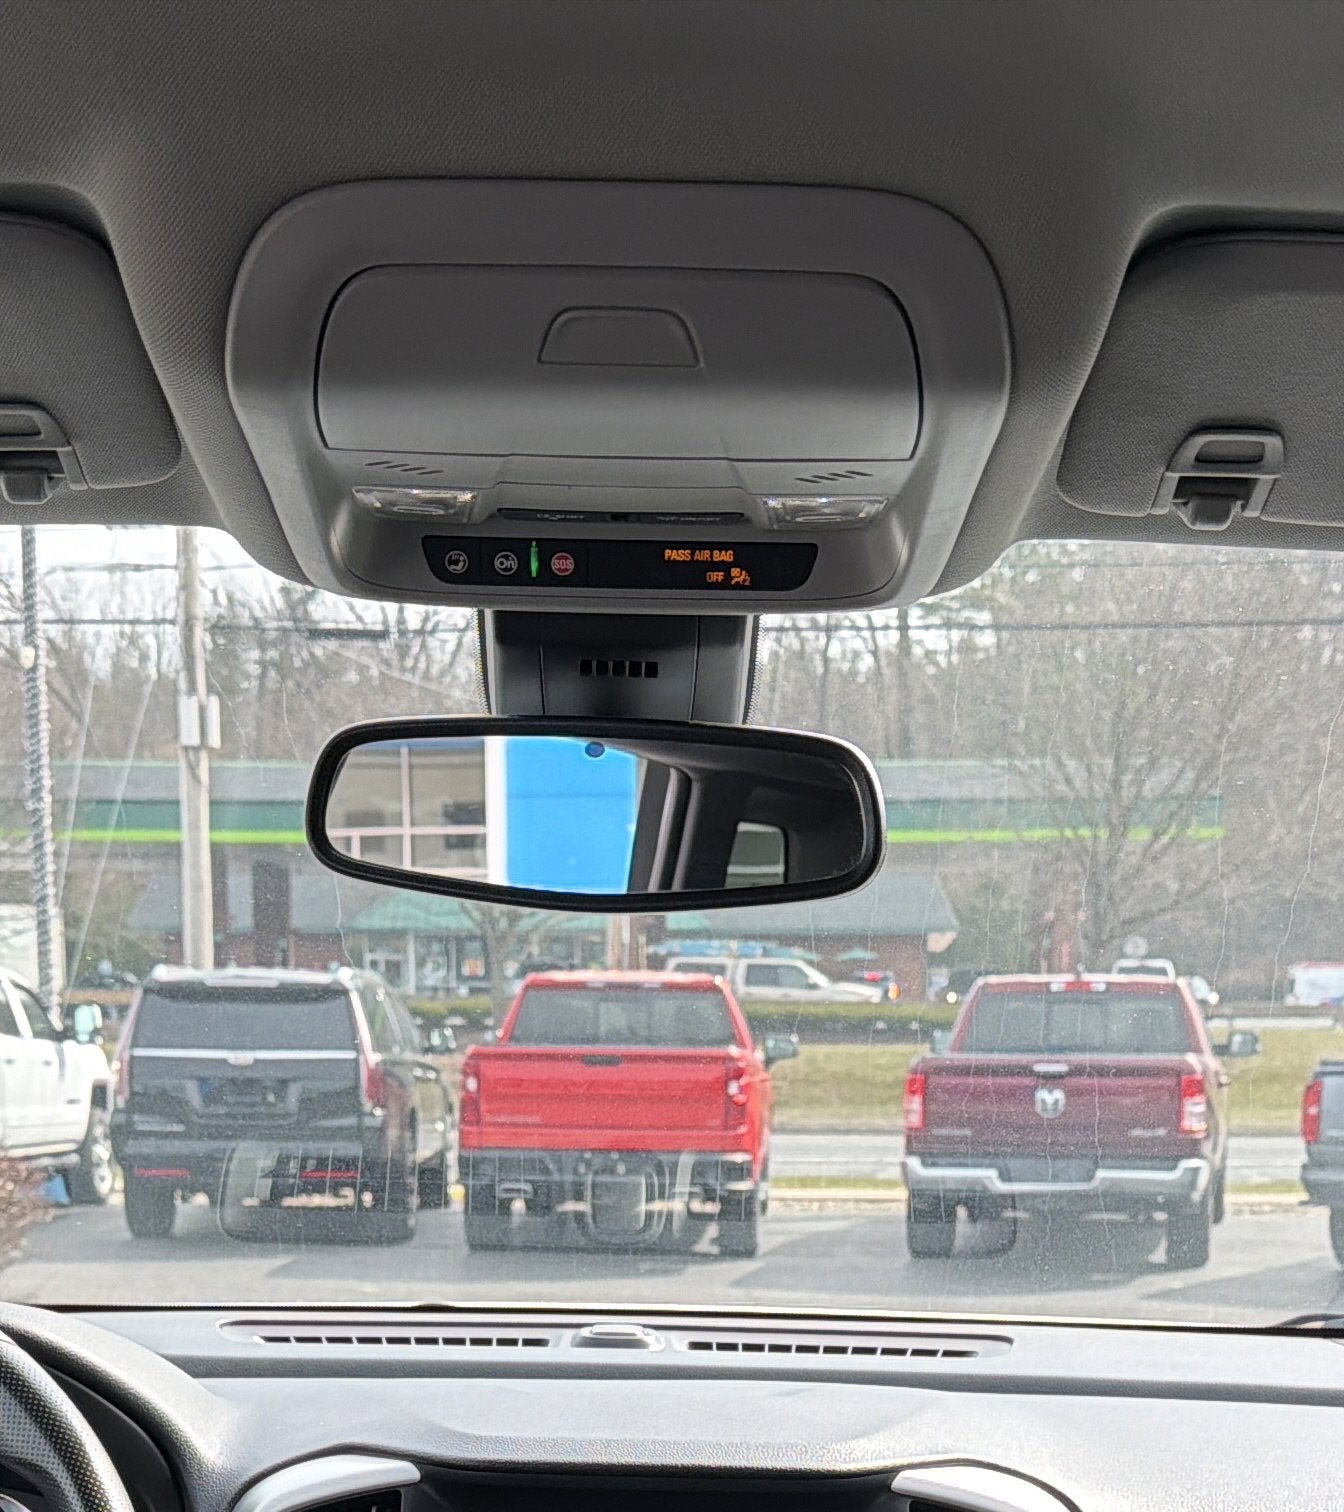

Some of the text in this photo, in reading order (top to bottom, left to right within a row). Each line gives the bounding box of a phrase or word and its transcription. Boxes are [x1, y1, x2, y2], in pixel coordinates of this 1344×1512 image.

[664, 549, 734, 562] PASS AIR BAG
[553, 558, 573, 570] SOS
[706, 571, 725, 583] OFF
